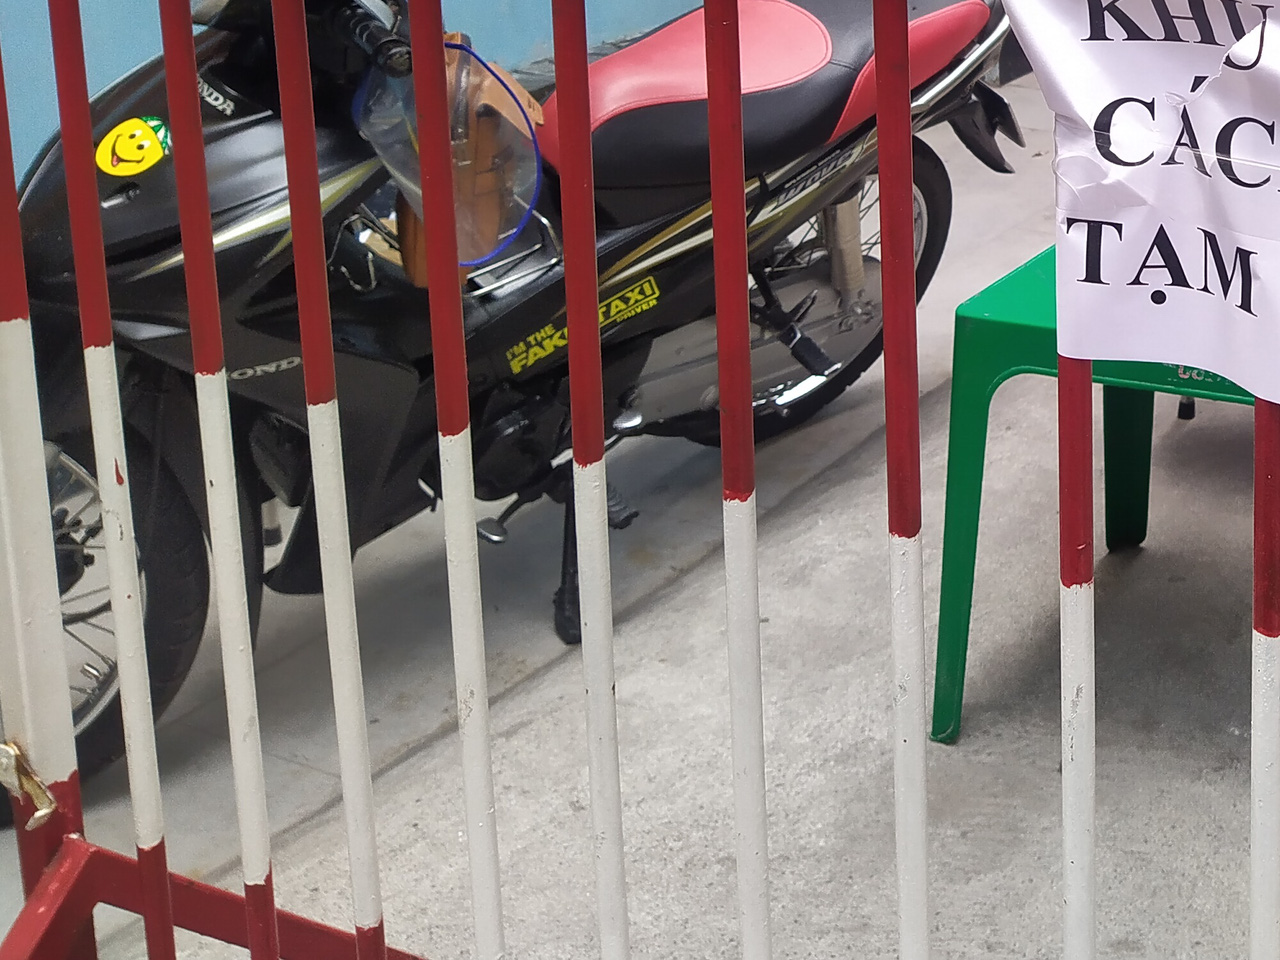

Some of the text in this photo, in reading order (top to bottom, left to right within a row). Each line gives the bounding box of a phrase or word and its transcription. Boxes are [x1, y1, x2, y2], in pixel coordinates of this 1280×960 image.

[1066, 217, 1258, 317] TẠM
[598, 281, 653, 323] TAXI
[526, 323, 556, 346] THE
[226, 356, 303, 380] OND
